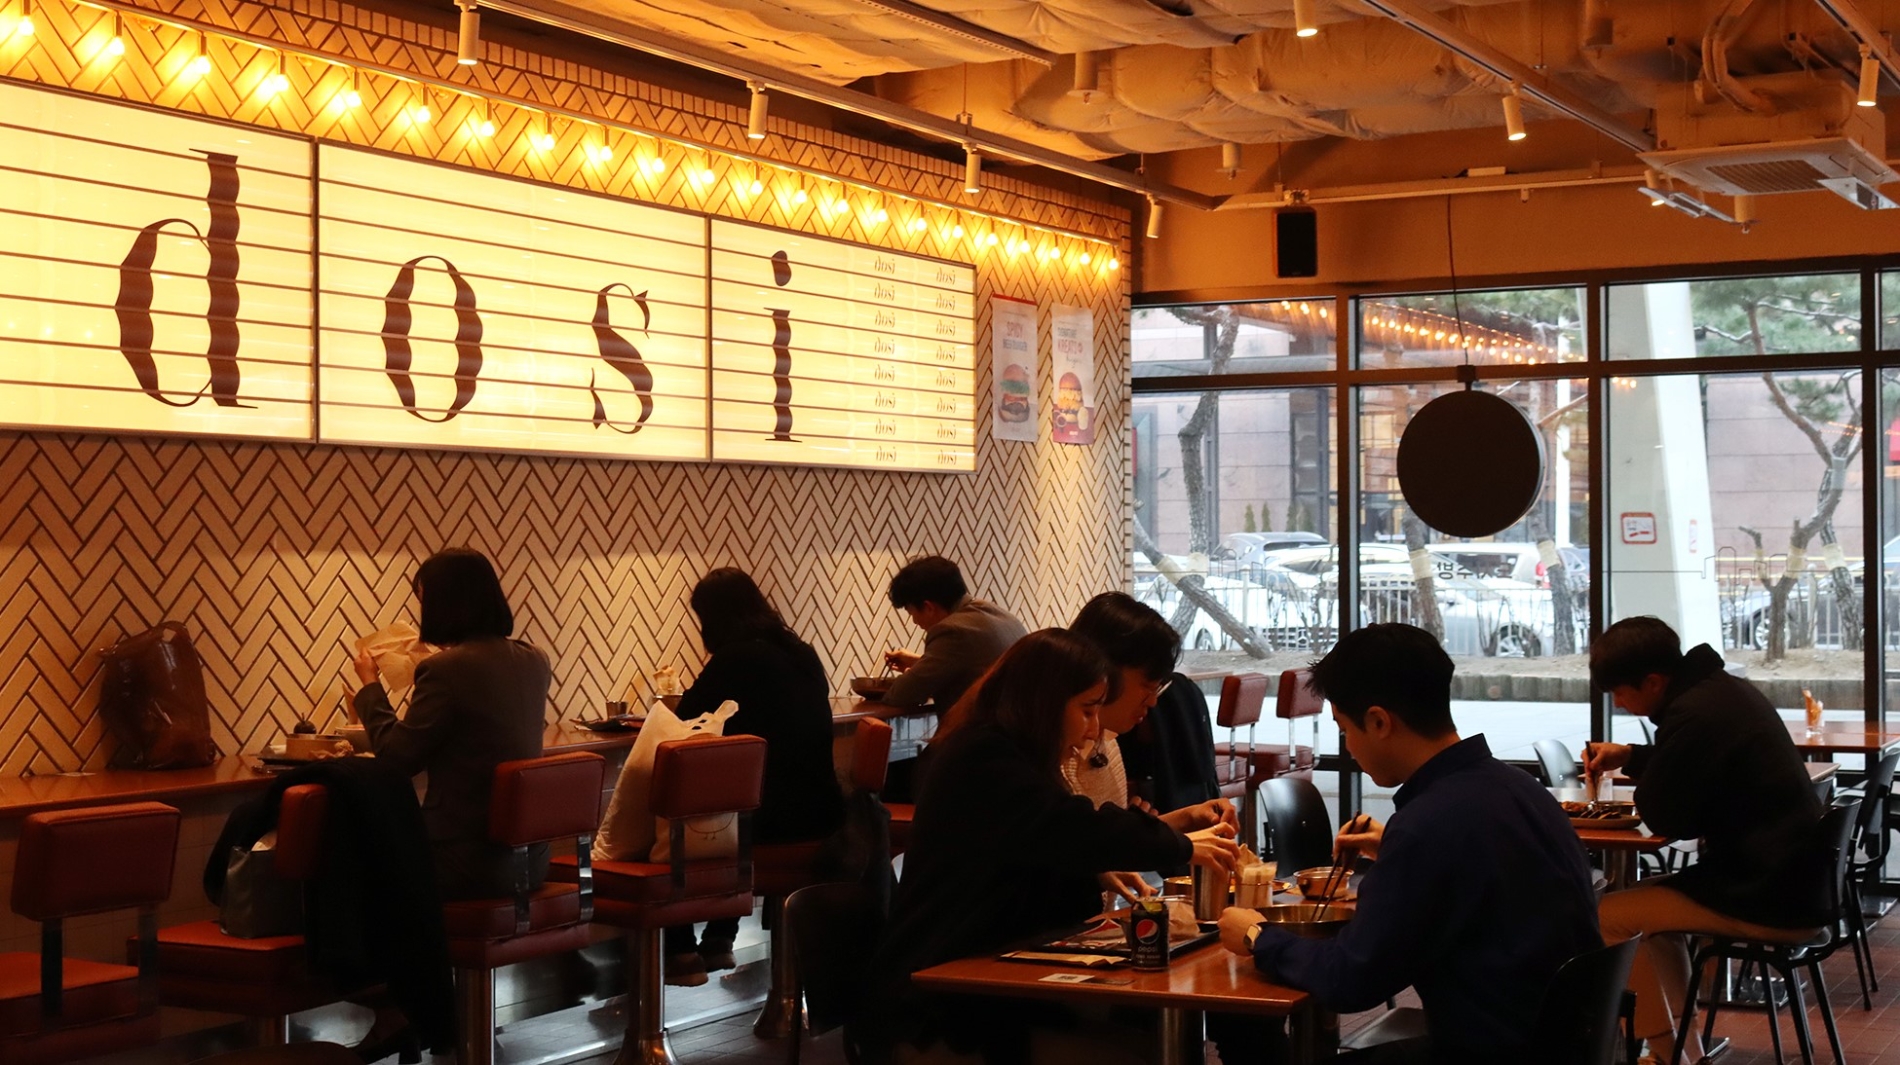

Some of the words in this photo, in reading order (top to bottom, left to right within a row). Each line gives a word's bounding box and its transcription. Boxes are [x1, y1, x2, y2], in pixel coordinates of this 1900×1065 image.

[874, 255, 896, 275] dosi
[935, 266, 956, 285] dosi
[115, 148, 803, 443] dosi
[874, 281, 897, 301] dosi
[936, 291, 957, 310] dosi
[875, 308, 897, 327] dosi
[936, 317, 957, 336] dosi
[874, 335, 897, 354] dosi
[936, 343, 957, 362] dosi
[874, 364, 895, 381] dosi
[936, 371, 955, 388] dosi
[875, 391, 896, 408] dosi
[937, 397, 956, 413] dosi
[875, 418, 896, 435] dosi
[937, 423, 956, 439] dosi
[876, 445, 896, 462] dosi
[938, 449, 957, 465] dosi
